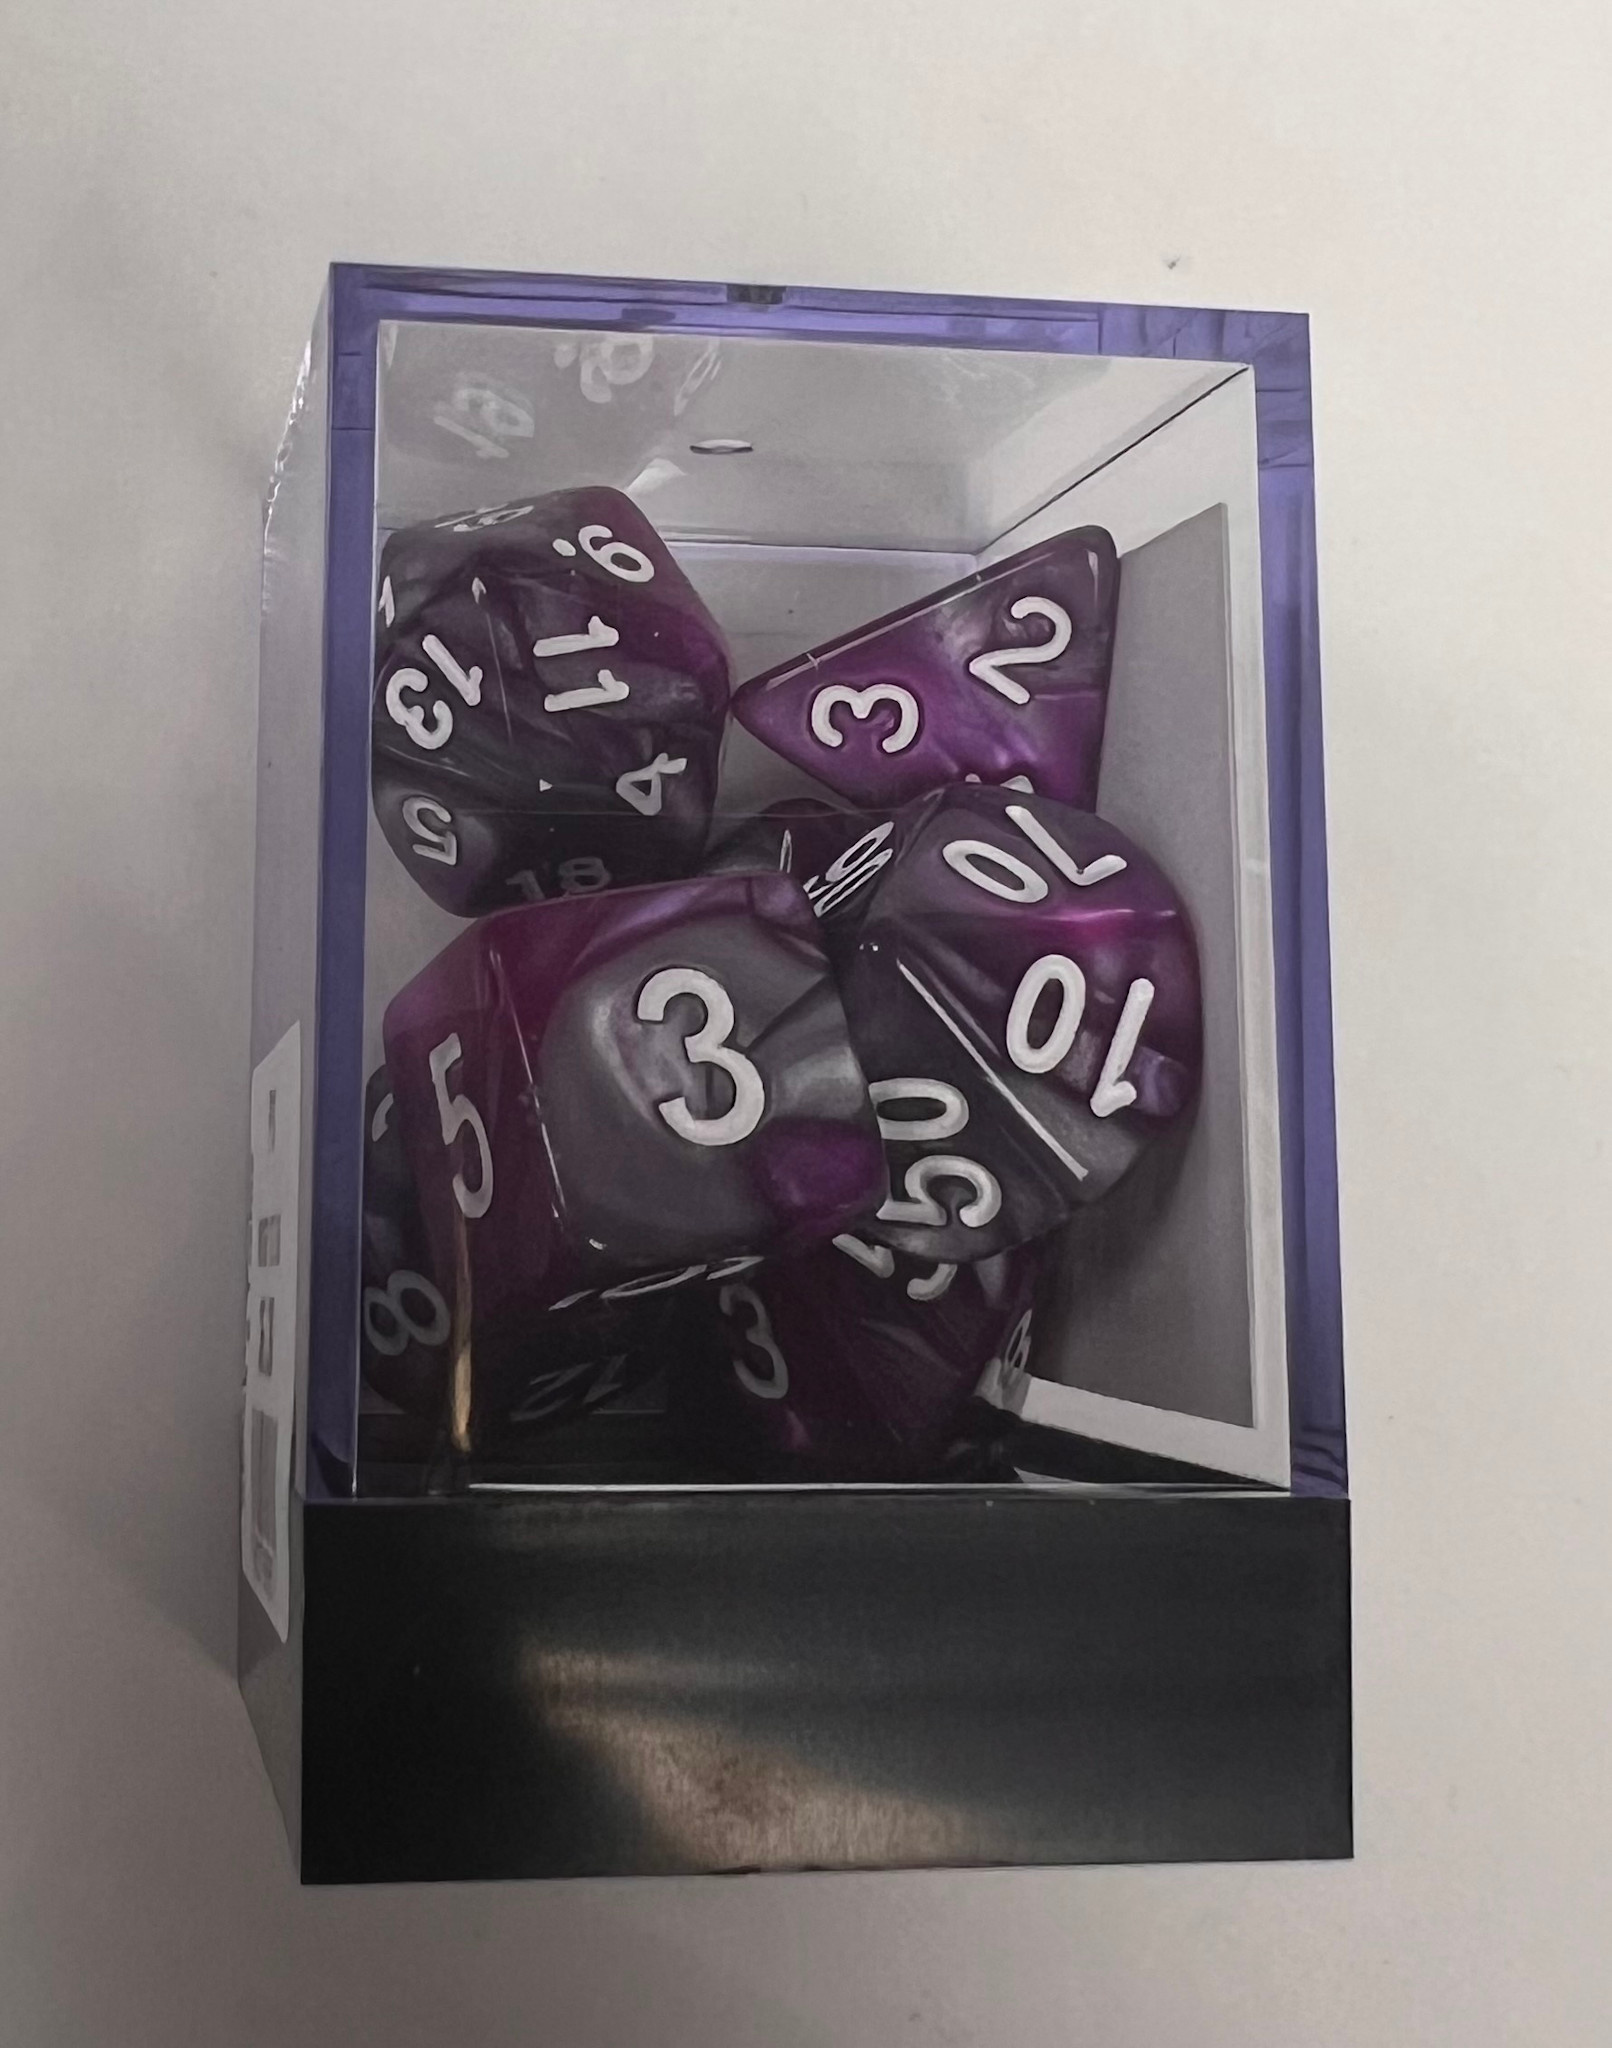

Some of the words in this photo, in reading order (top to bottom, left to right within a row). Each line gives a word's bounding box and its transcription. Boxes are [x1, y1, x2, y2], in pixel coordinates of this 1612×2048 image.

[386, 634, 483, 750] 13
[532, 616, 631, 712] 11
[969, 596, 1072, 704] 2
[811, 683, 919, 753] 3
[402, 797, 457, 865] 5
[616, 753, 688, 816] 4
[943, 805, 1128, 902] 70
[637, 968, 765, 1146] 3
[1006, 954, 1155, 1117] 10
[429, 1033, 494, 1218] 5
[869, 1078, 1002, 1228] 50
[363, 1270, 450, 1355] 8
[720, 1285, 789, 1399] 3
